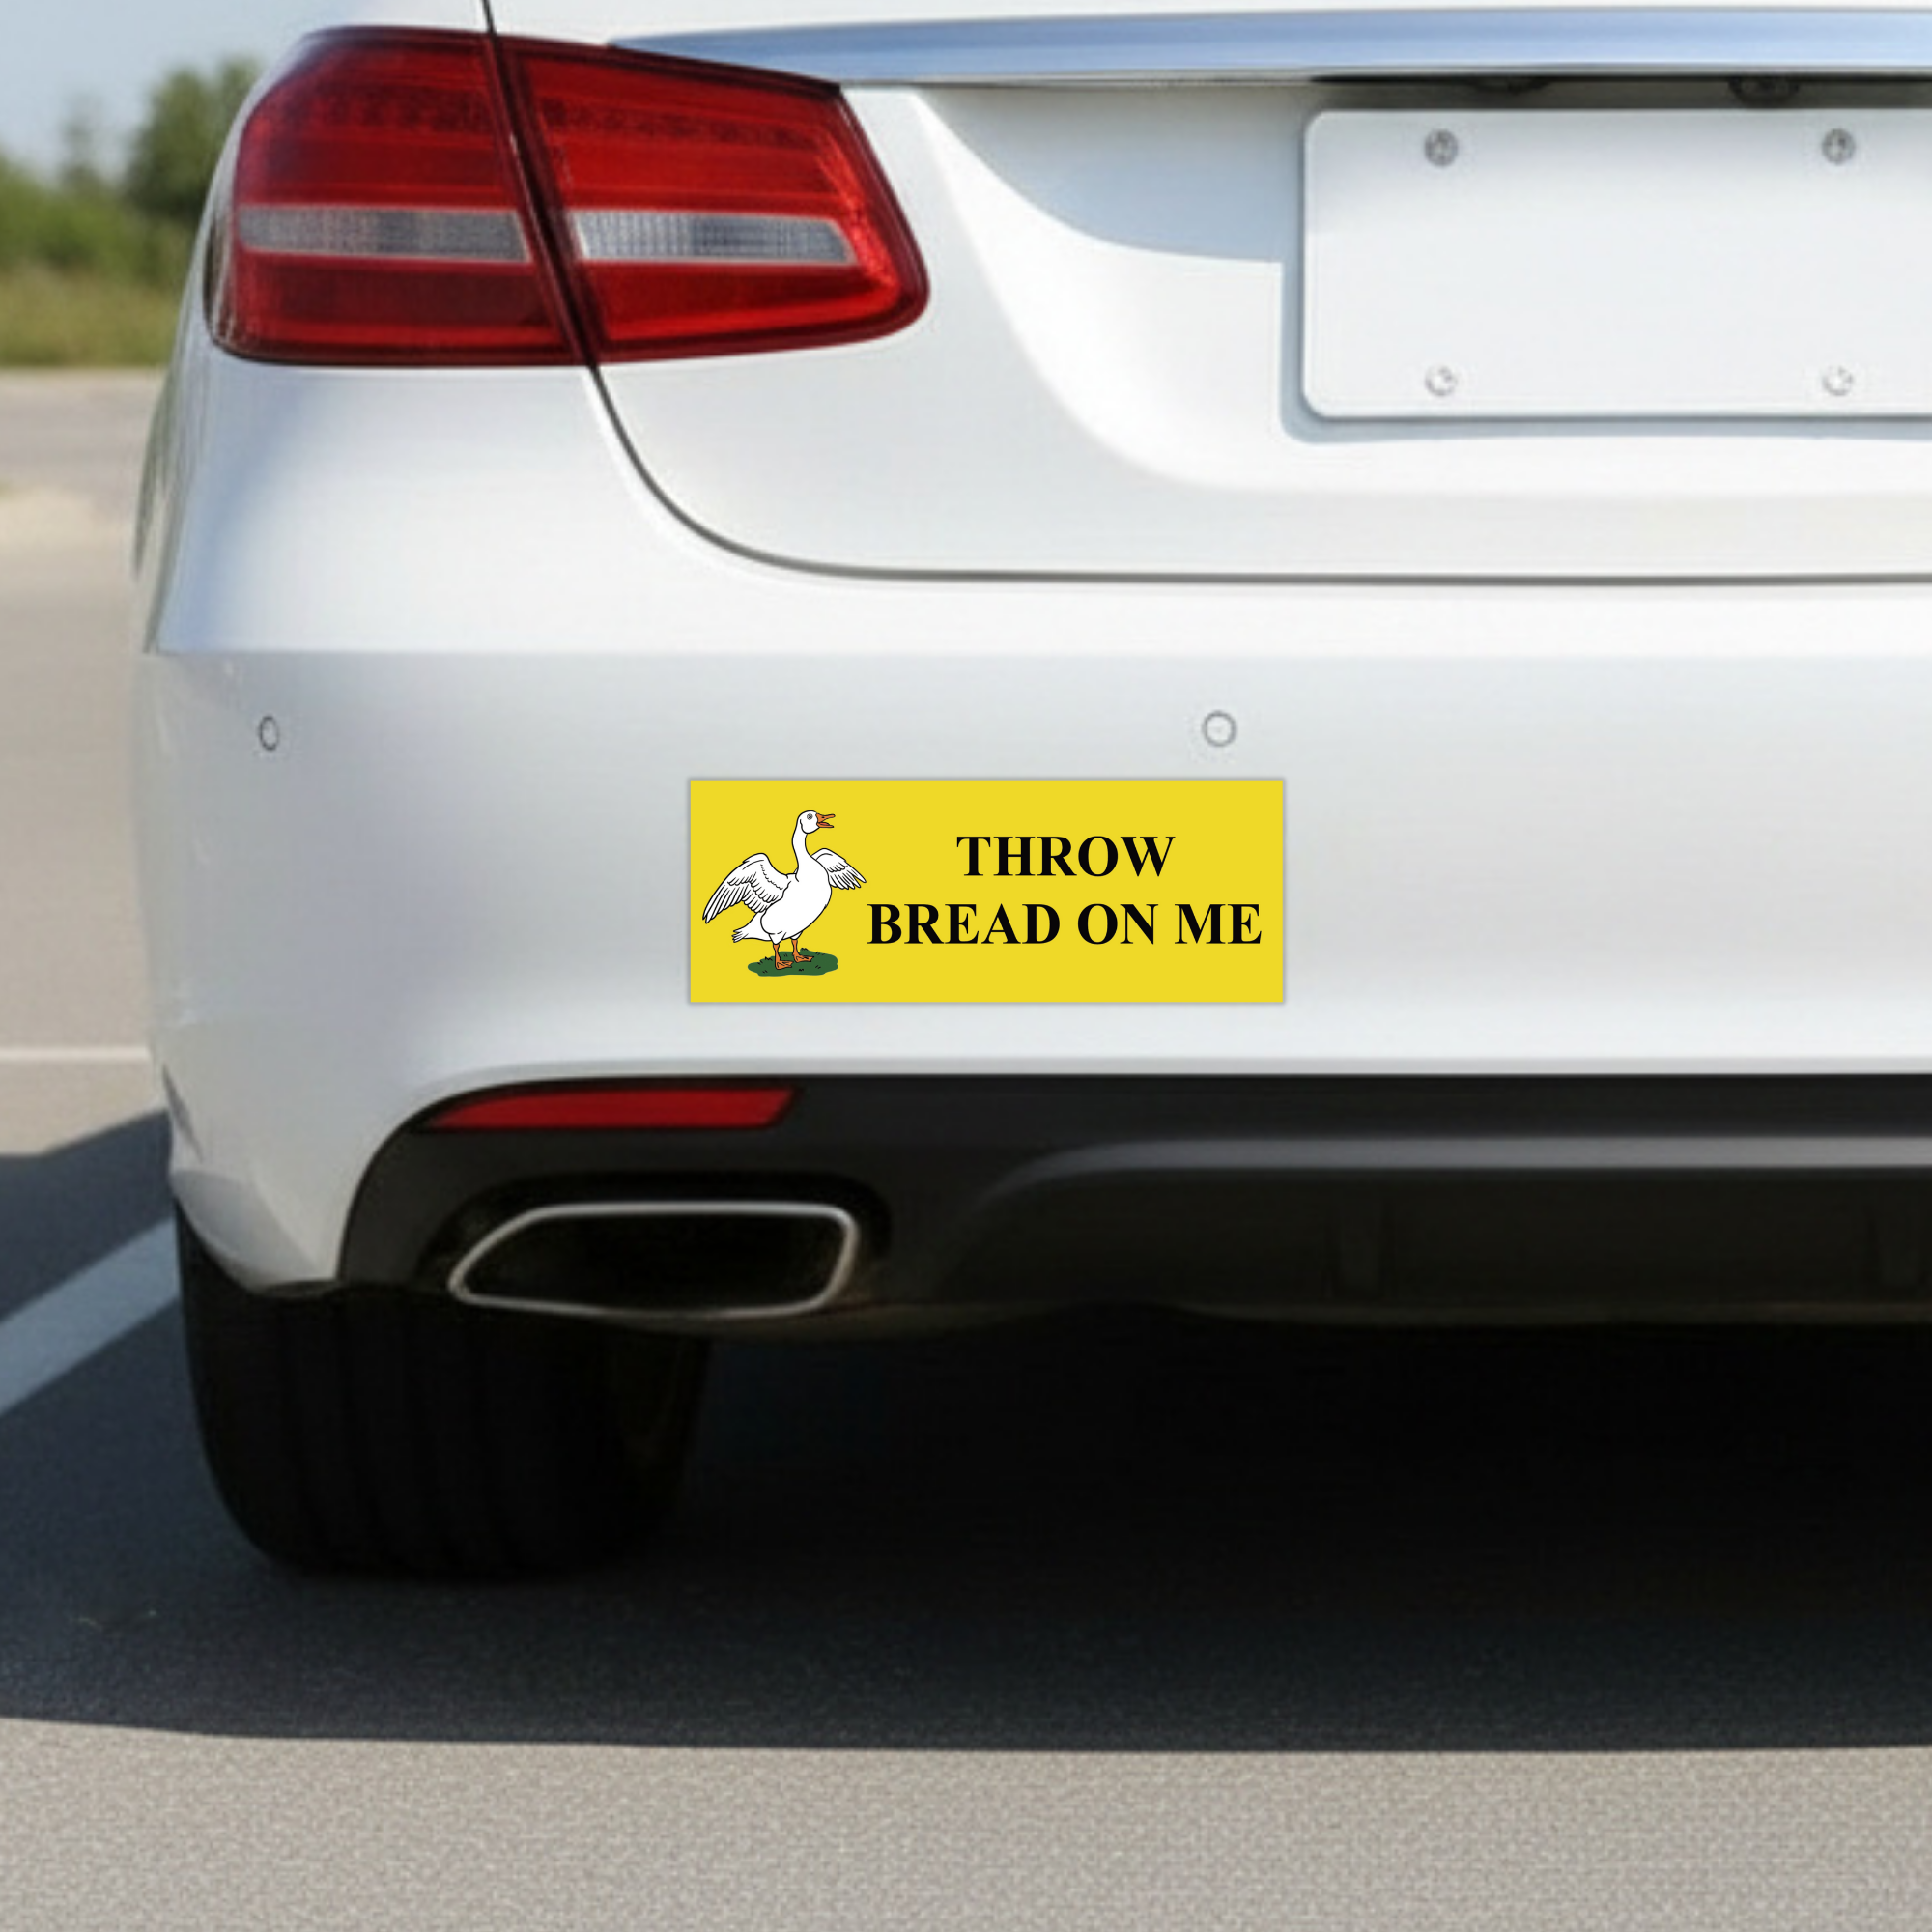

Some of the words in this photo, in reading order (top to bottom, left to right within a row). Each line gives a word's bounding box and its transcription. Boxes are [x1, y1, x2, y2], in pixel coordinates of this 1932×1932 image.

[956, 836, 1176, 877] THROW
[867, 903, 1061, 945] BREAD
[1077, 903, 1159, 945] ON
[1174, 903, 1263, 945] ME
